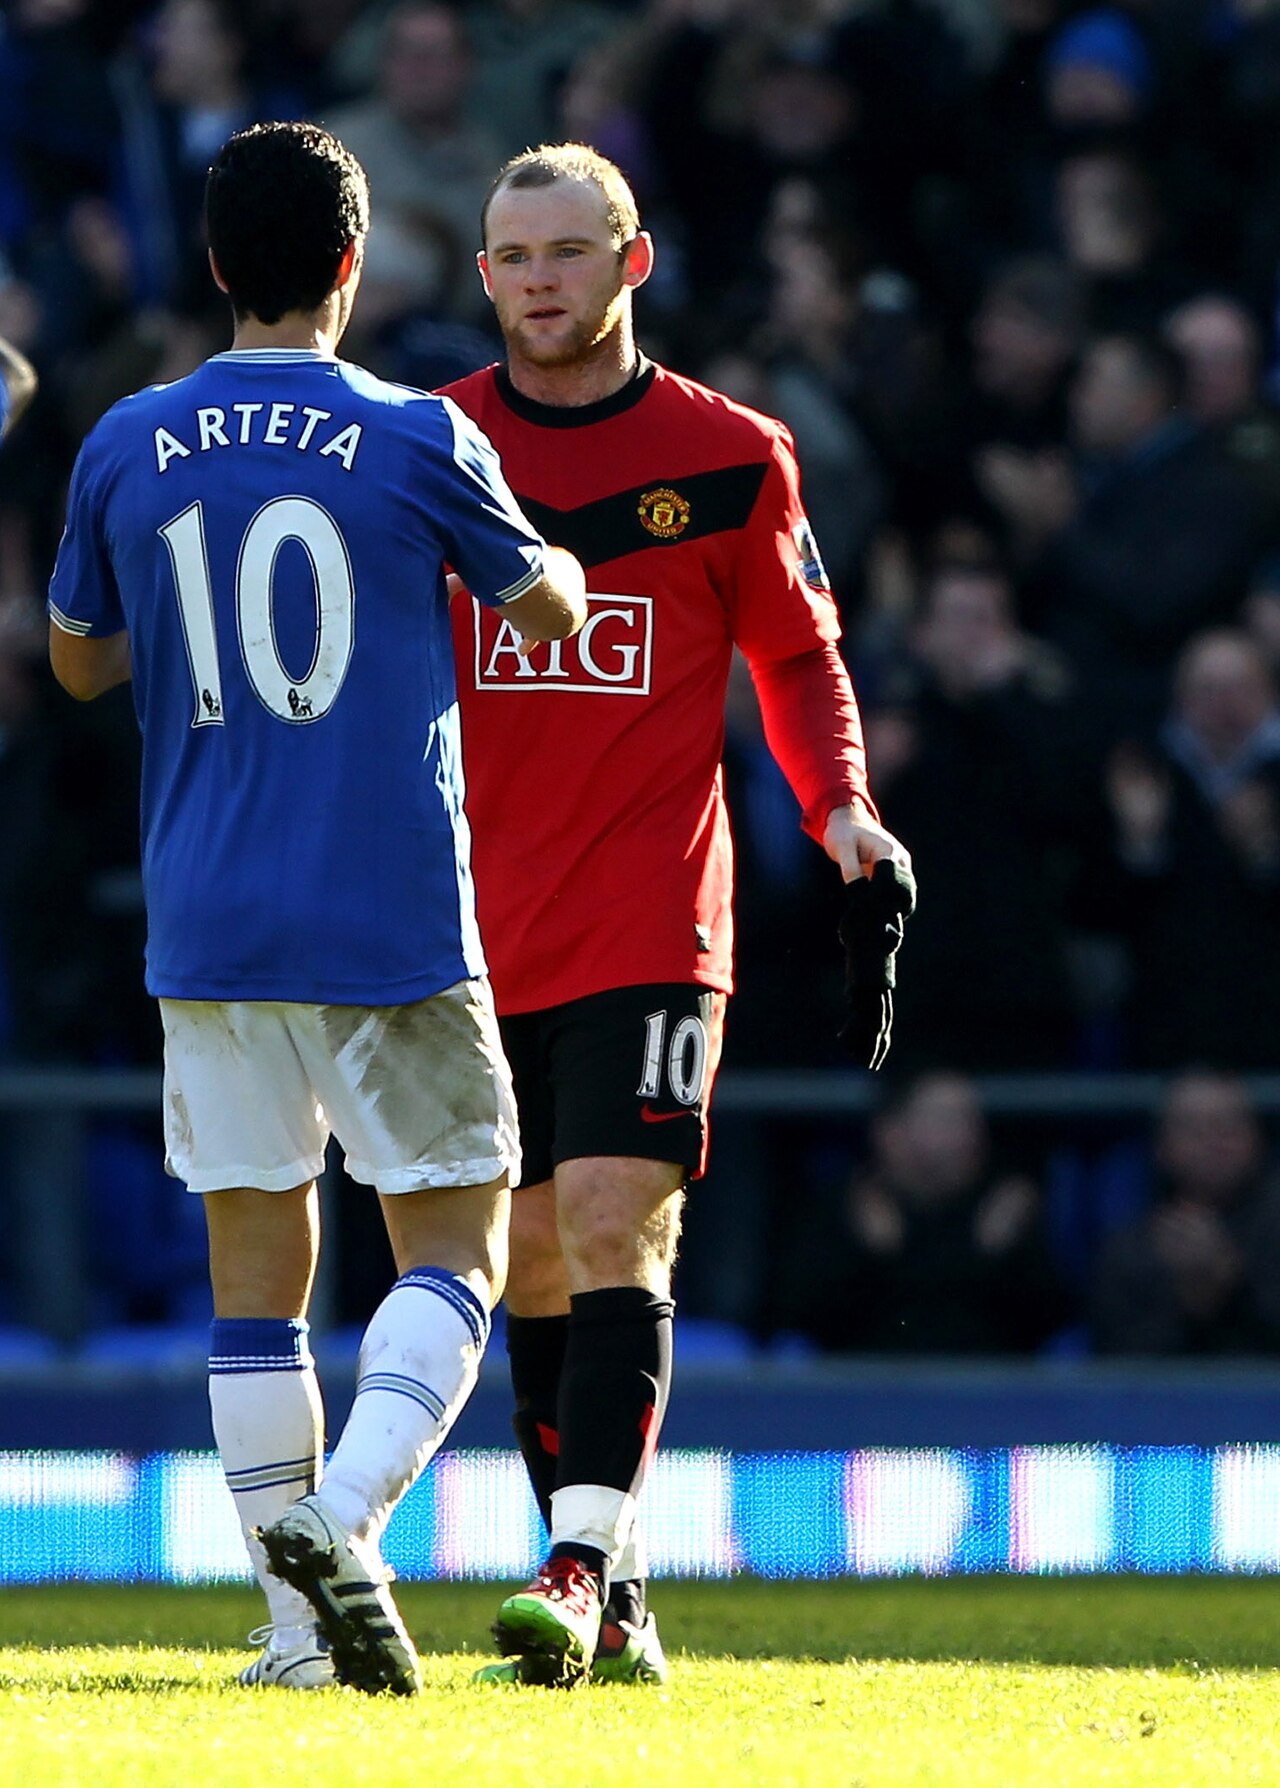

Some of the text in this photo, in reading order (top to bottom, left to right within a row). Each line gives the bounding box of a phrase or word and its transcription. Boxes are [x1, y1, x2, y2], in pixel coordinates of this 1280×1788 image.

[153, 402, 363, 473] ARTETA
[157, 495, 355, 727] 10
[636, 1009, 708, 1105] 10
